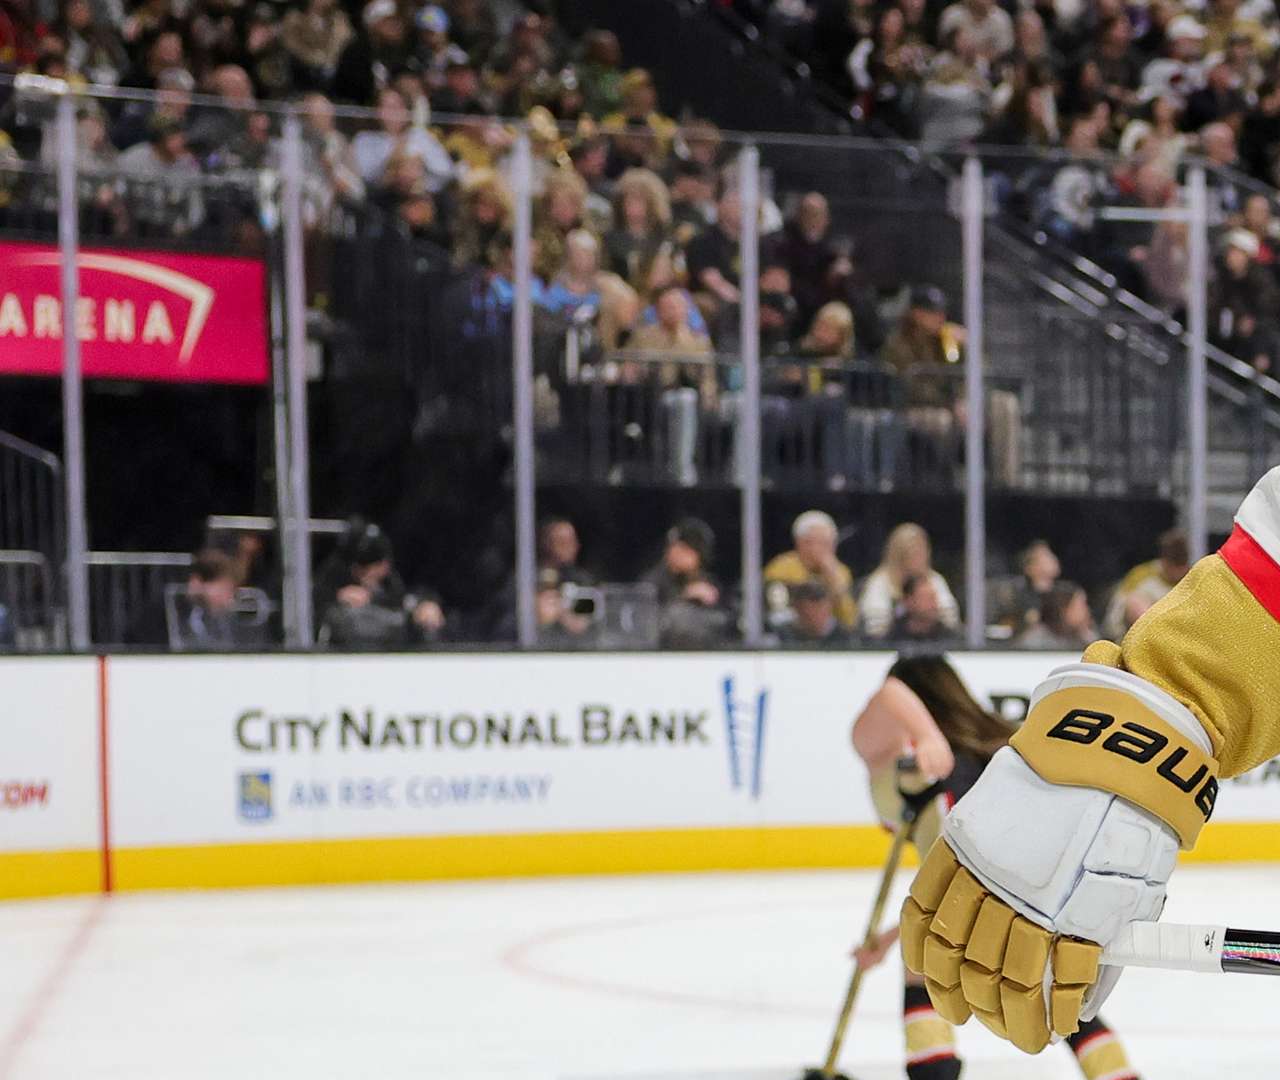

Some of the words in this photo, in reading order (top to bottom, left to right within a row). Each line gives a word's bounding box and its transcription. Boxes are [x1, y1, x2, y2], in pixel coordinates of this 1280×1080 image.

[0, 293, 174, 344] ARENA
[236, 709, 328, 752] CITY
[340, 706, 571, 750] NATIONAL
[581, 705, 709, 746] BANK
